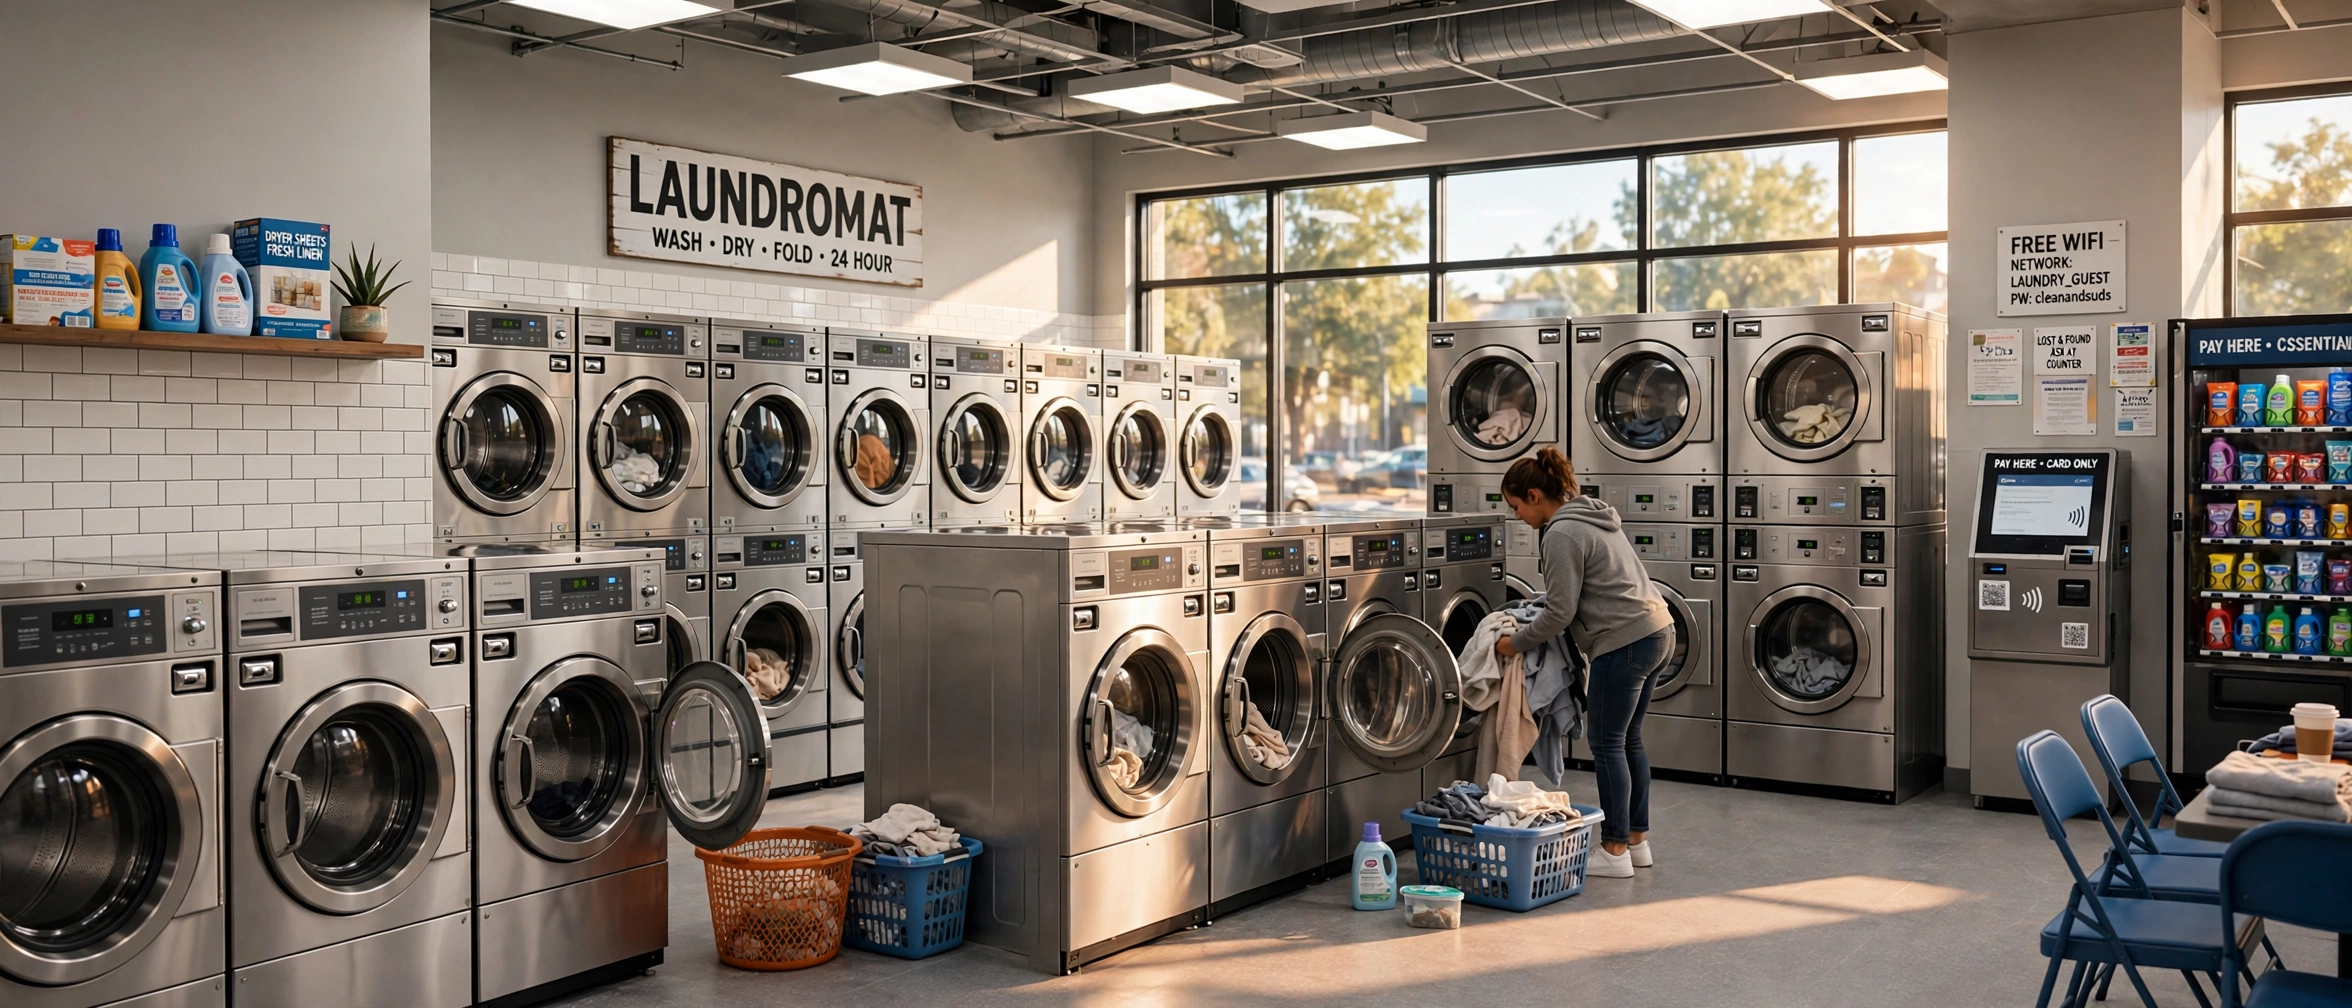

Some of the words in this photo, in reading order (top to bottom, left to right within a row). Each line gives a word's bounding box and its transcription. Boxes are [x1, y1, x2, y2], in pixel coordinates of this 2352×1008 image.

[630, 154, 911, 246] LAUNDROMAT
[265, 230, 293, 245] DRYER
[293, 233, 327, 248] SHEETS
[2011, 234, 2057, 255] FREE
[2062, 231, 2103, 251] WIFI
[267, 243, 295, 258] FRESH
[296, 245, 323, 261] LINEN
[652, 227, 702, 252] WASH
[723, 235, 755, 258] DRY
[774, 242, 813, 263] FOLD
[831, 249, 848, 268] 24
[853, 251, 893, 273] HOUR
[2011, 256, 2072, 271] NETWORK:
[2011, 271, 2110, 288] LAUNDRY_GUEST
[2011, 292, 2032, 305] PW:
[2035, 288, 2112, 304] cleanandsuds
[2037, 335, 2056, 346] LOST
[2057, 335, 2064, 345] &
[2065, 333, 2092, 344] FOUND
[2199, 339, 2224, 354] PAY
[2227, 338, 2262, 353] HERE
[2067, 347, 2076, 357] AT
[2046, 359, 2082, 369] COUNTER
[1994, 458, 2011, 469] PAY
[2013, 458, 2037, 469] HERE
[2046, 458, 2071, 469] CARD
[2073, 458, 2099, 469] ONLY
